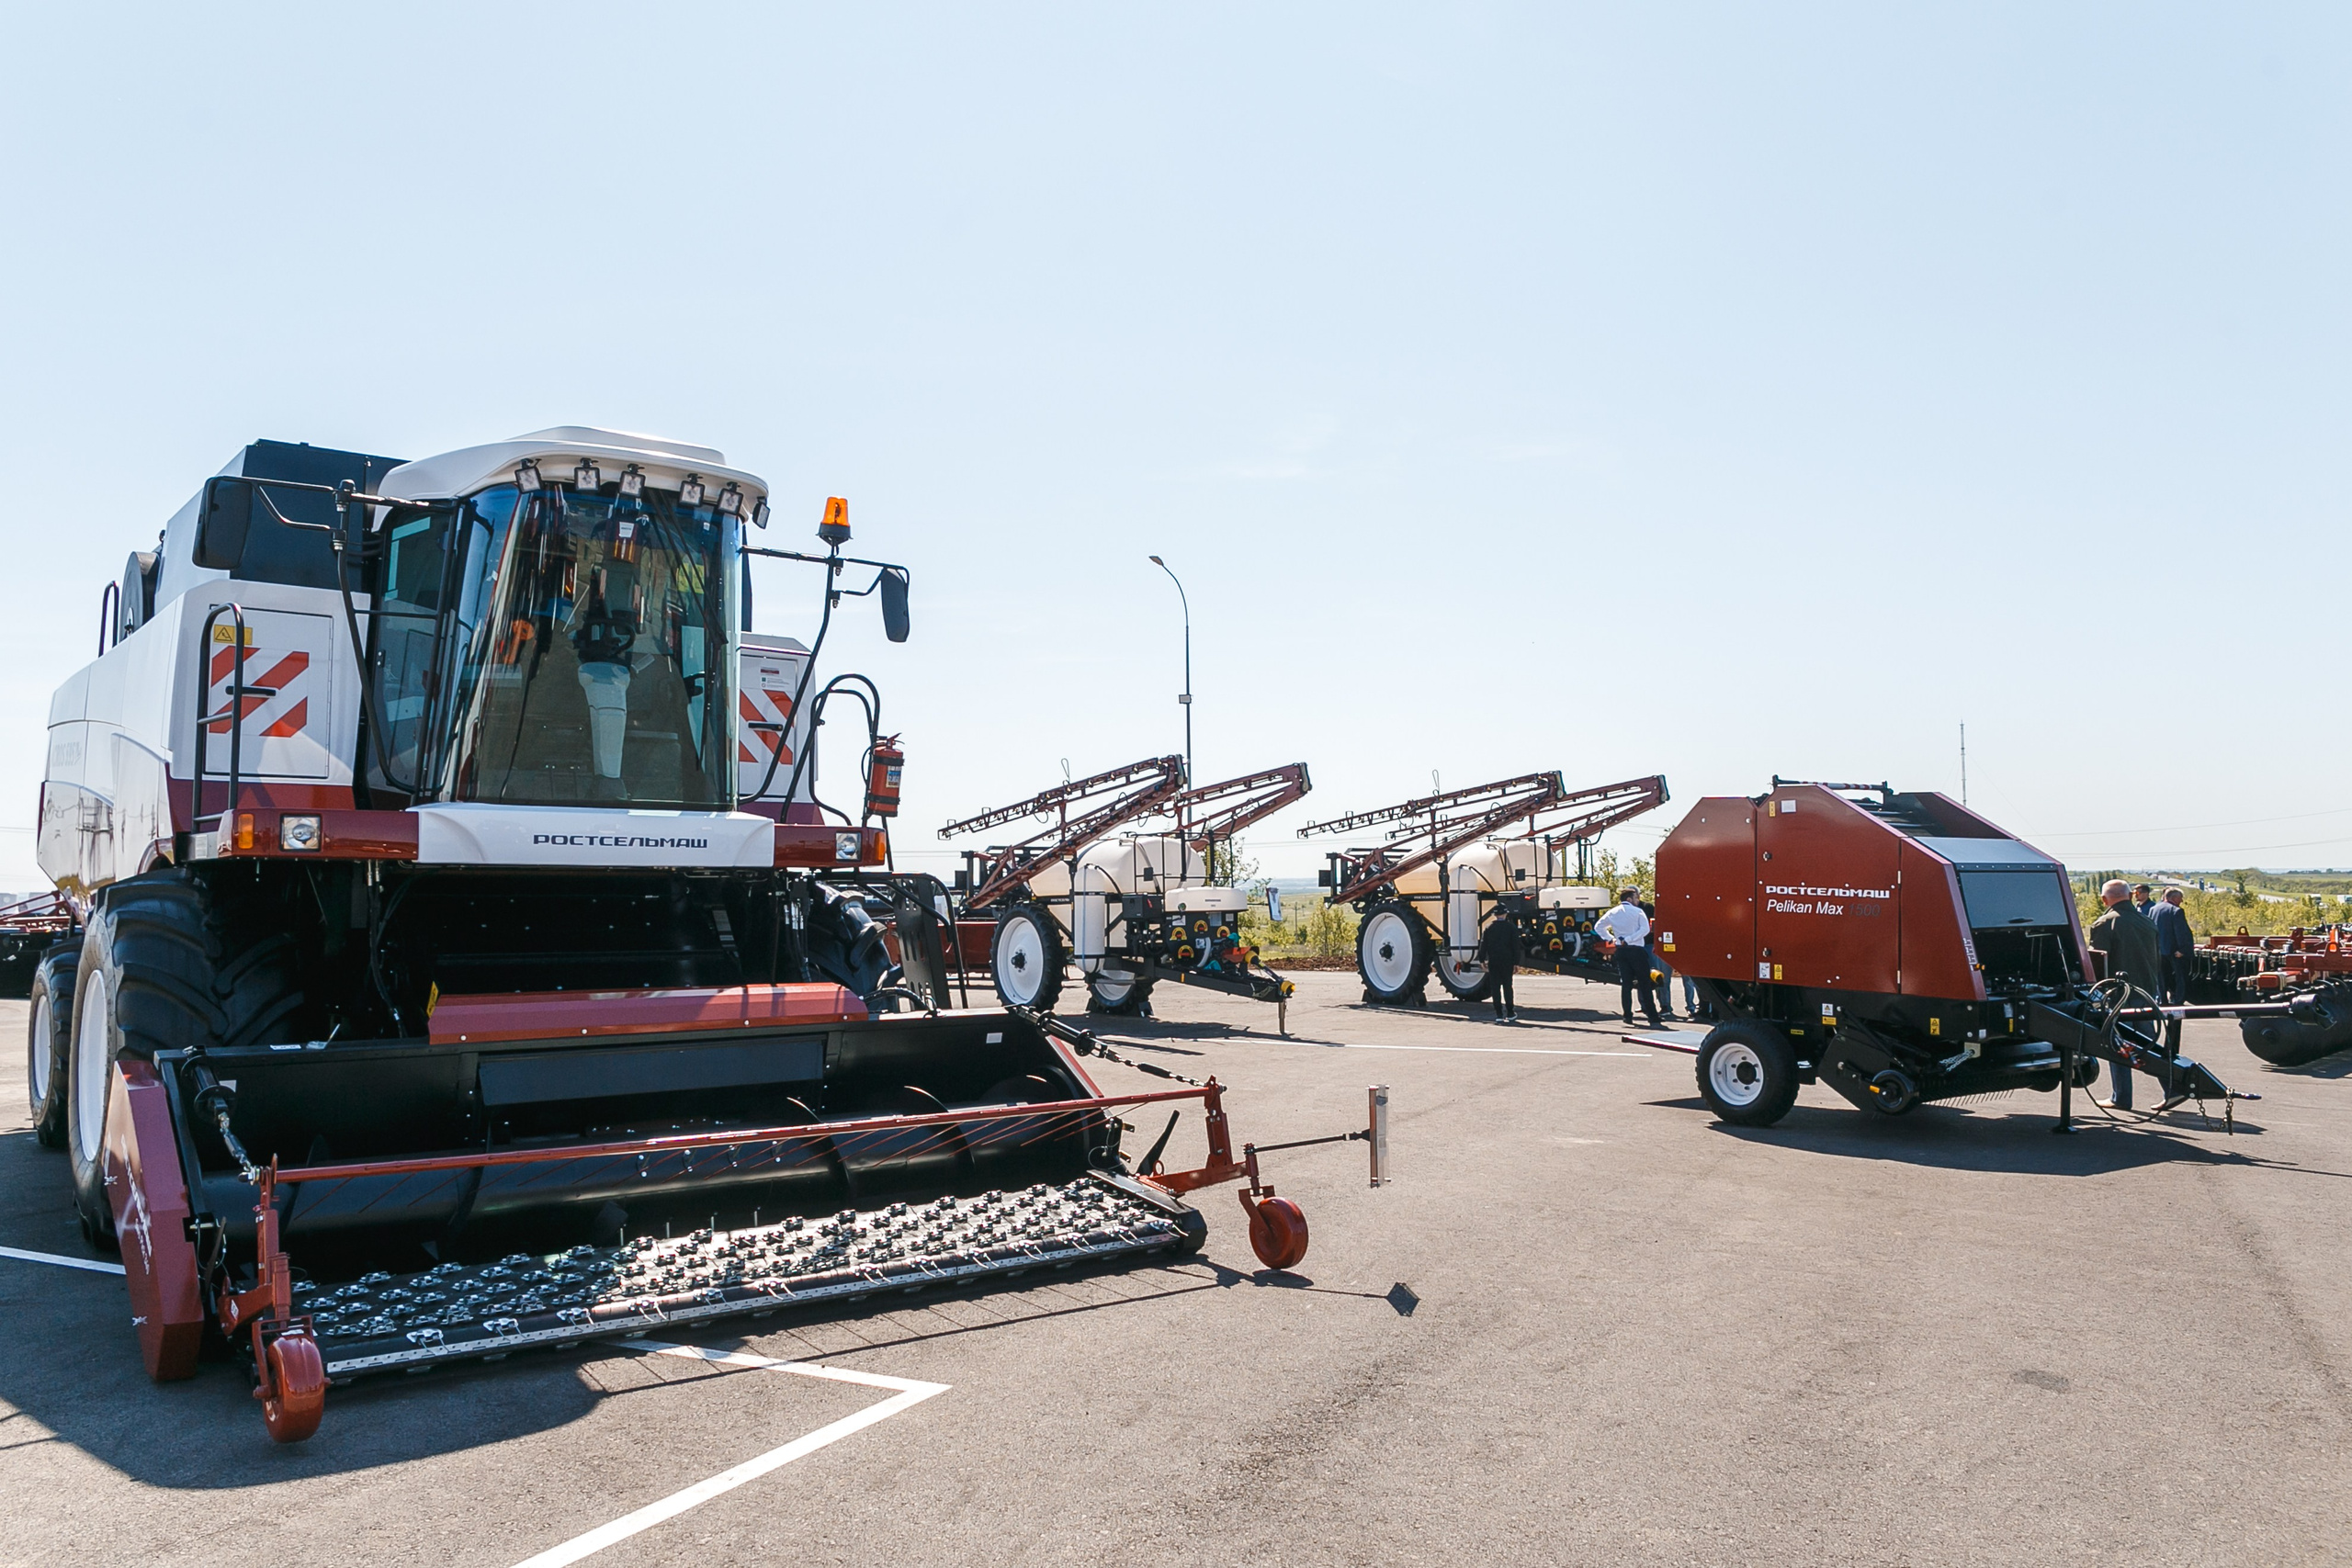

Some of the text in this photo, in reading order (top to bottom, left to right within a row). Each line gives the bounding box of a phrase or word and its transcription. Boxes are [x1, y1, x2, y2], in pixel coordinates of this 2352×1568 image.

[533, 834, 707, 849] РОСТСЕЛЬМАШ
[1765, 886, 1890, 898] РОСТСЕЛЬМАШ
[1767, 899, 1881, 917] Pelikan Max 1500
